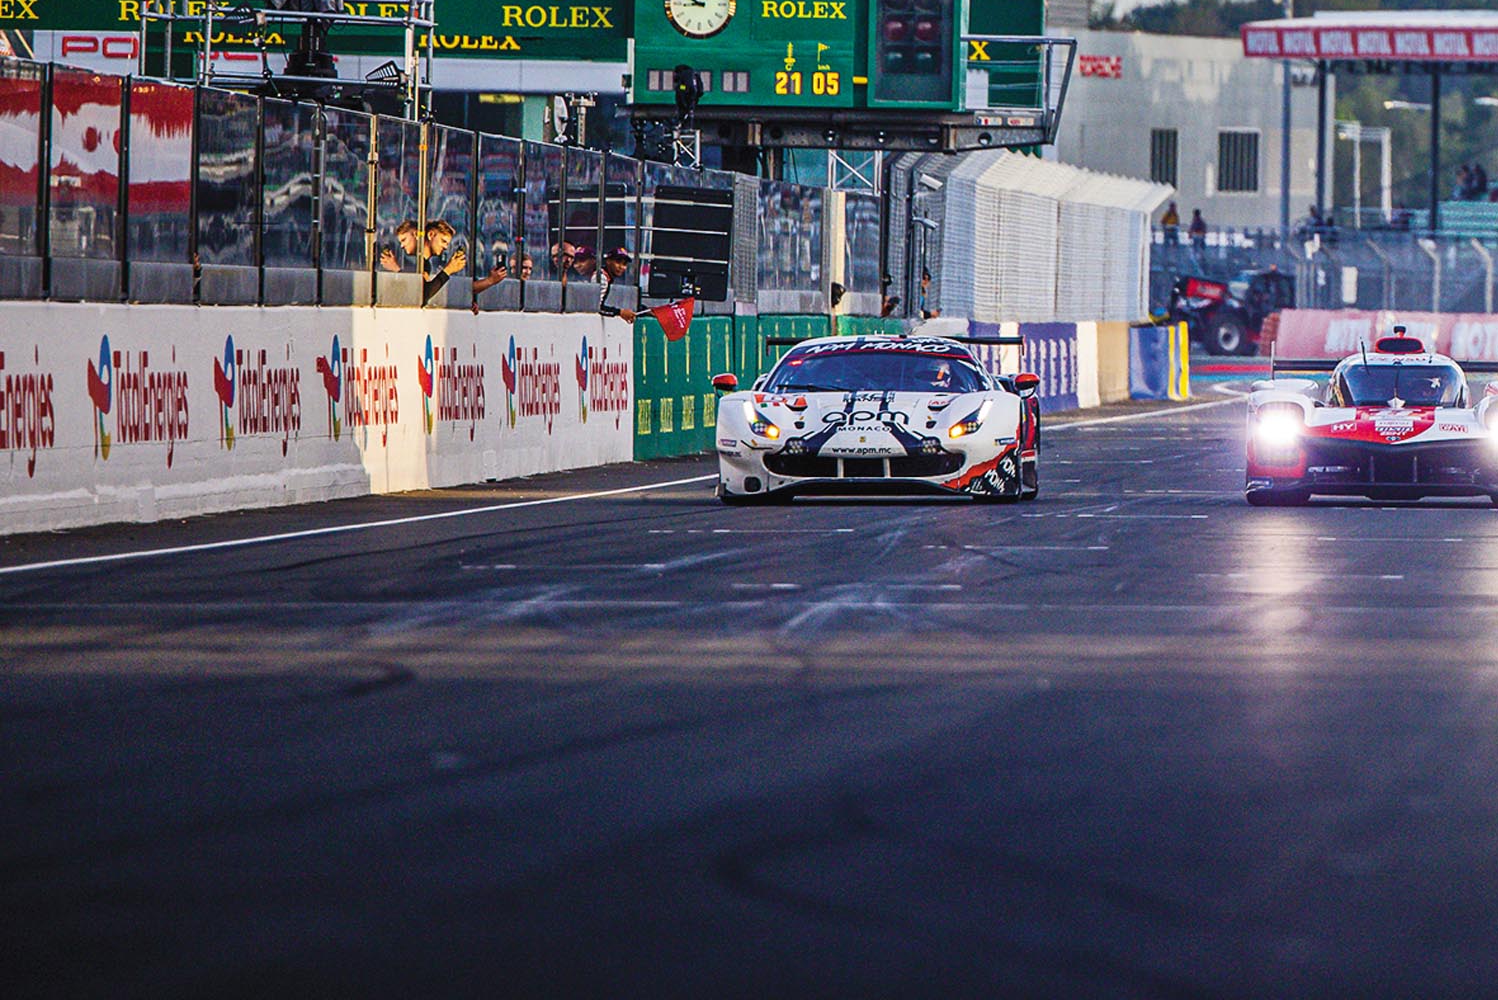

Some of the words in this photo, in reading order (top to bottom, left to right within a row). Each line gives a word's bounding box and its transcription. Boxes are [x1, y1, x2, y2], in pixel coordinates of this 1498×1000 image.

[501, 4, 614, 28] ROLEX
[761, 0, 847, 19] ROLEX
[774, 70, 802, 96] 21
[812, 70, 840, 96] 05
[860, 342, 951, 353] MONACO
[112, 344, 190, 470] TotalEnergies
[821, 410, 910, 425] apm
[1332, 423, 1354, 432] HY
[831, 446, 892, 455] www.apm.mc
